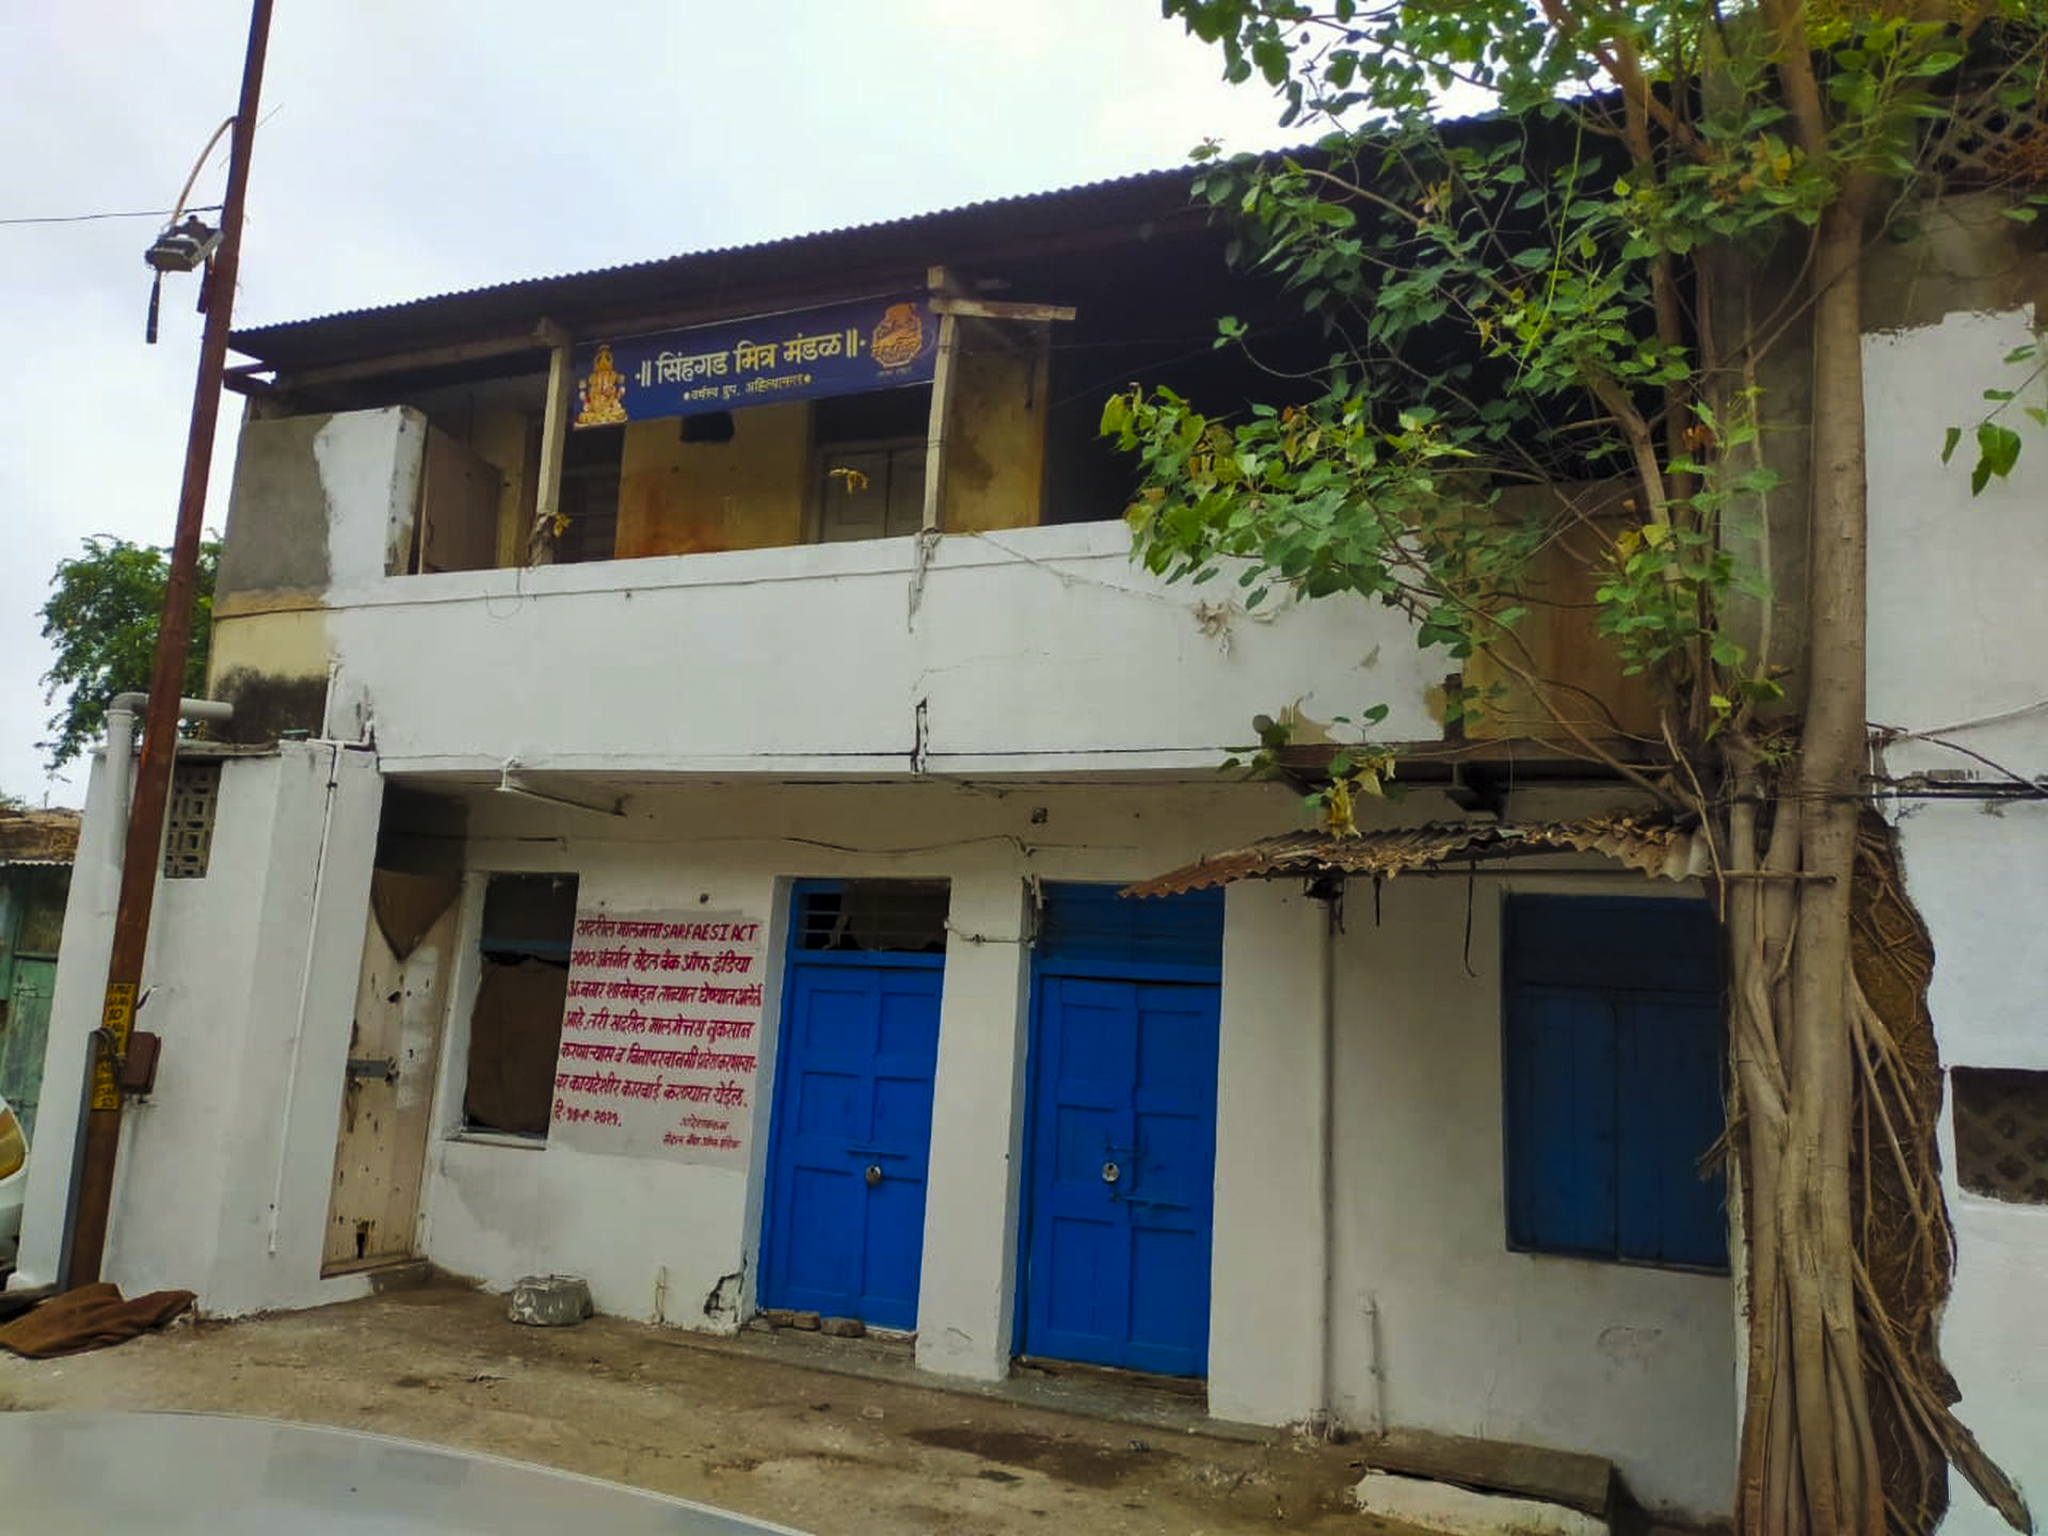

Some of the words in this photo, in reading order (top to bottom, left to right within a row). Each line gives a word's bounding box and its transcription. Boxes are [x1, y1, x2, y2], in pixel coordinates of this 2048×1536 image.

[655, 351, 729, 385] सिंहगड
[732, 340, 778, 374] मित्र
[783, 332, 842, 364] मंडळ
[731, 924, 758, 941] ACT
[712, 950, 753, 976] इंडिया
[588, 1006, 610, 1030] तरी
